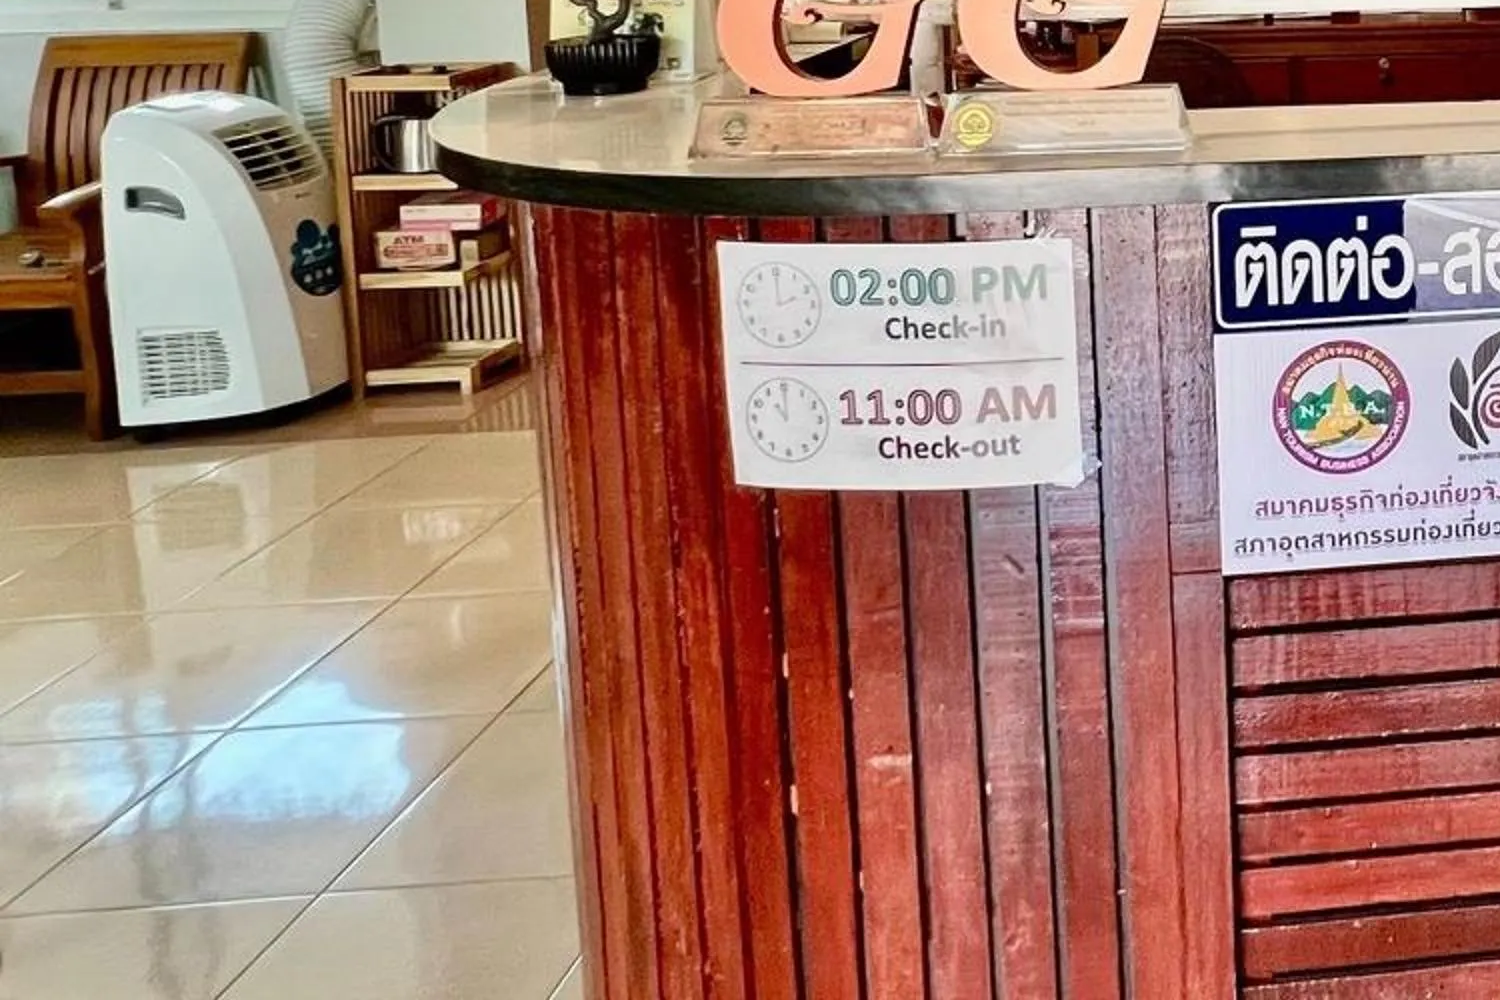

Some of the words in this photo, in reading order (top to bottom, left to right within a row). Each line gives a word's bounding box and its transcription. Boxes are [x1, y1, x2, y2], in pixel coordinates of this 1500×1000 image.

[830, 267, 957, 307] 02:00
[971, 263, 1049, 303] PM
[885, 313, 1007, 341] Check-in
[839, 389, 962, 426] 11:00
[976, 383, 1058, 424] AM
[878, 434, 1022, 461] Check-out
